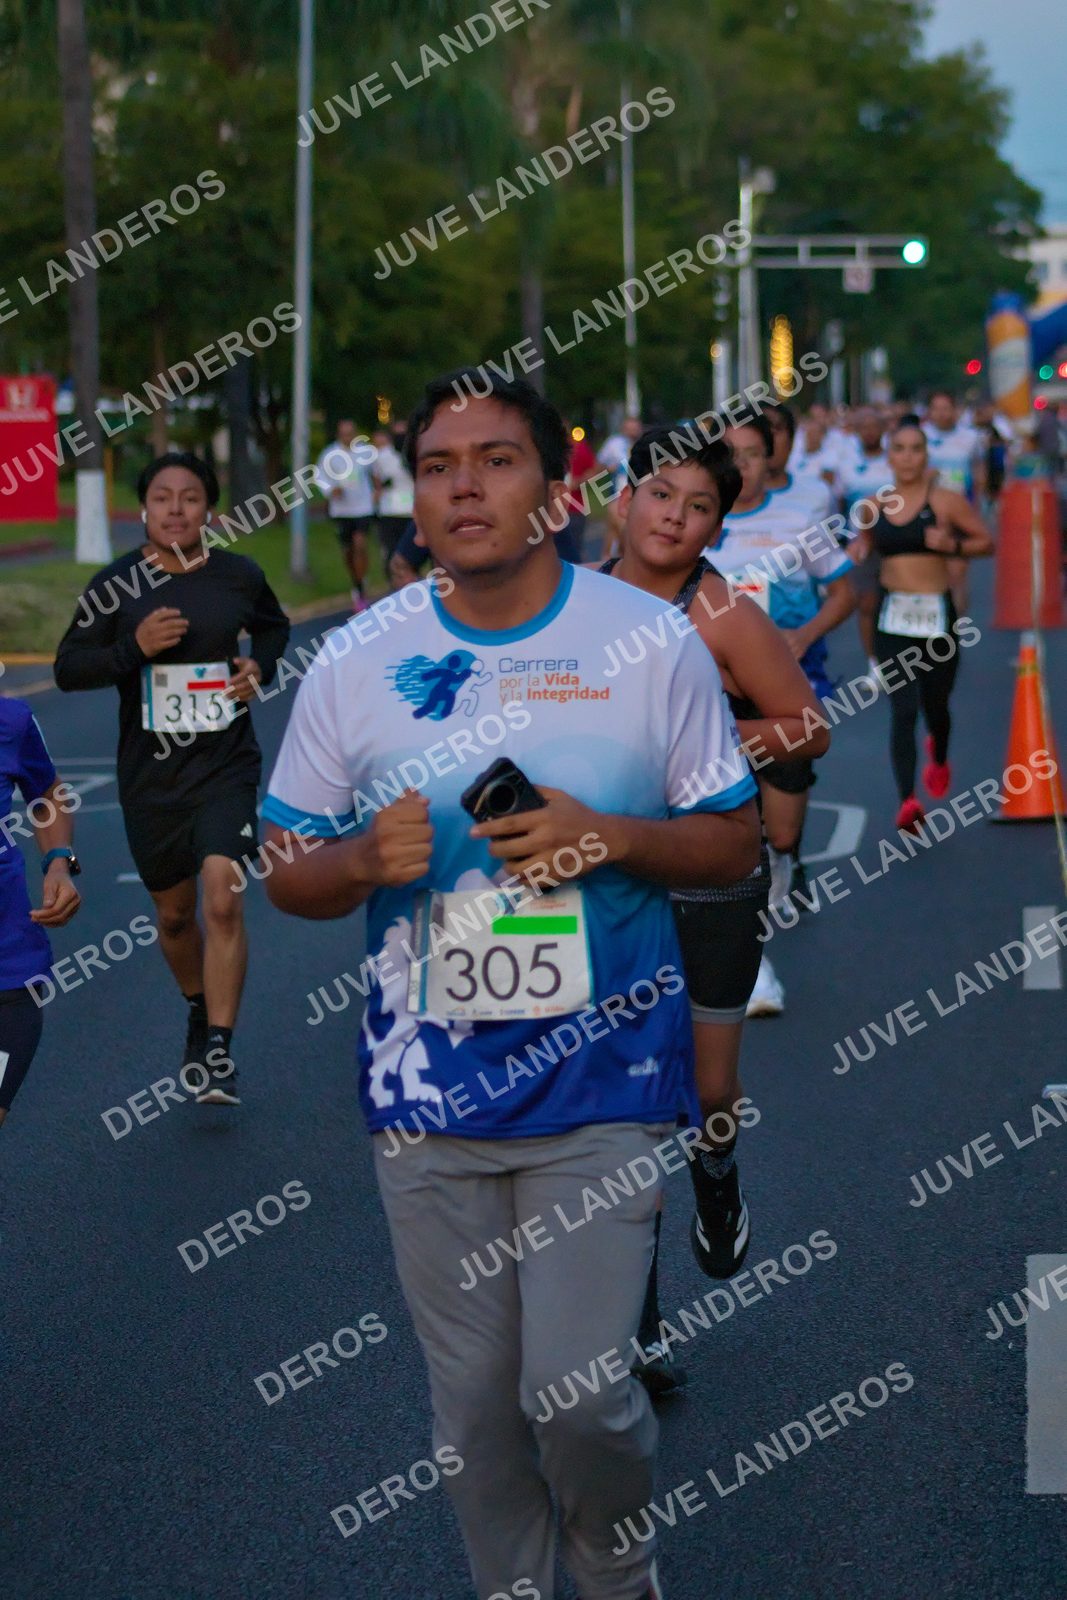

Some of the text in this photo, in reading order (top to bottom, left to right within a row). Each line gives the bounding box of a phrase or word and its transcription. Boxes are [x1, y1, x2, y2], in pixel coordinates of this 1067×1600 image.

[498, 657, 578, 673] Carrera
[500, 672, 580, 690] por la Vida
[500, 686, 610, 705] y la Integridad
[165, 693, 223, 722] 315
[444, 942, 561, 1002] 305
